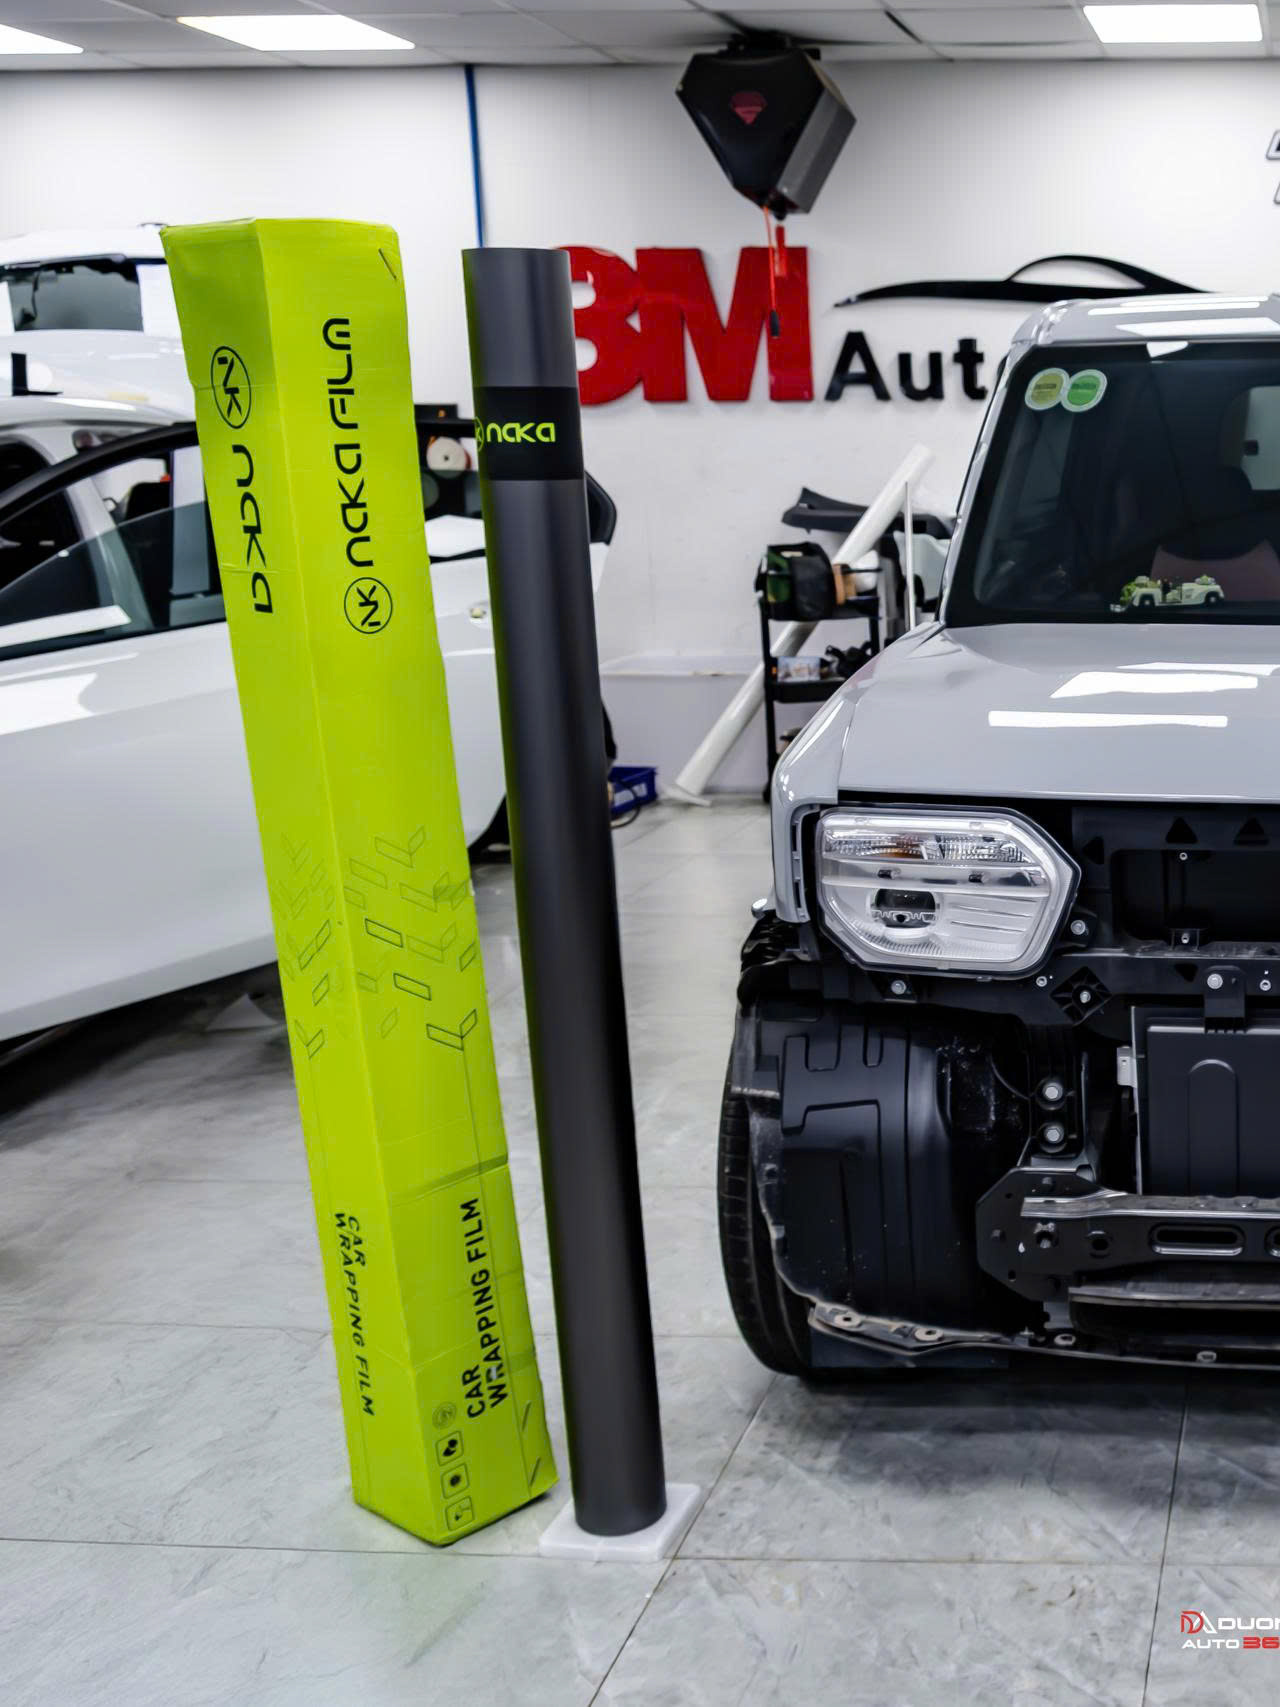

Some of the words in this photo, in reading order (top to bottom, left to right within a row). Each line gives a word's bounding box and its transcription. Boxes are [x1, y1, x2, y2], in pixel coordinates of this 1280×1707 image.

[557, 246, 813, 407] 3M
[825, 331, 1006, 402] Aut
[486, 421, 557, 443] naka
[348, 1215, 366, 1267] CAR
[459, 1197, 488, 1264] FILM
[334, 1212, 366, 1348] WRAPPING
[355, 1354, 376, 1417] FILM
[470, 1267, 509, 1409] WRAPPING
[461, 1363, 487, 1419] CAR
